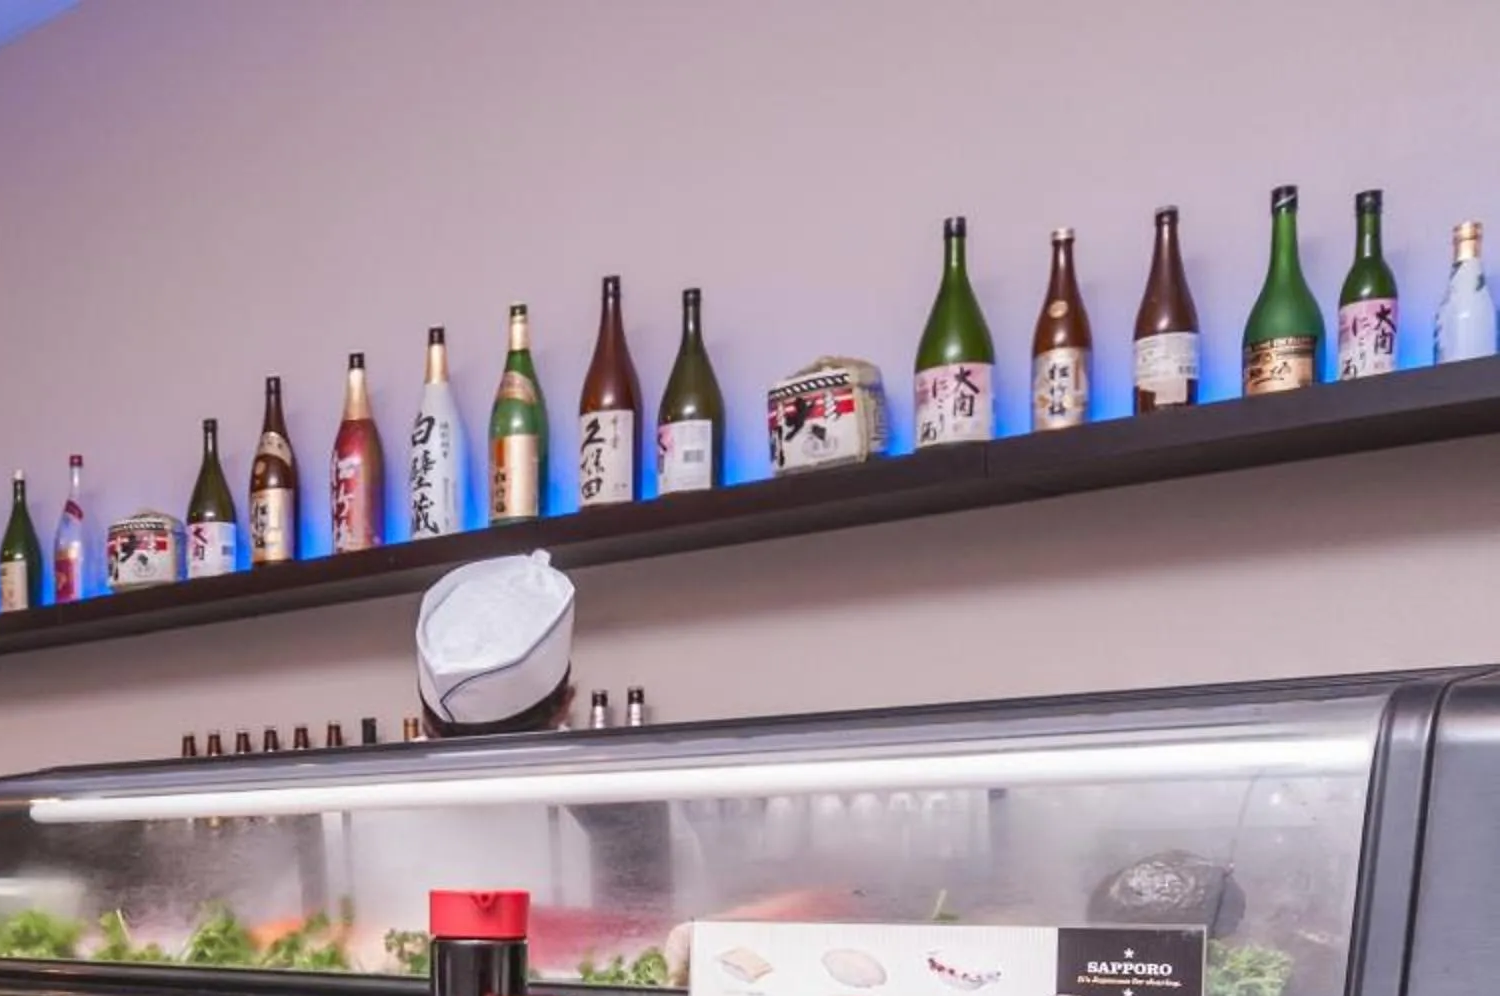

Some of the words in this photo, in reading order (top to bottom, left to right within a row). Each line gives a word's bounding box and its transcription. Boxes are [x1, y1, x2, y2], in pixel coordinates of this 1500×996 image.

[580, 418, 606, 500] 久保田
[1087, 961, 1173, 976] SAPPORO
